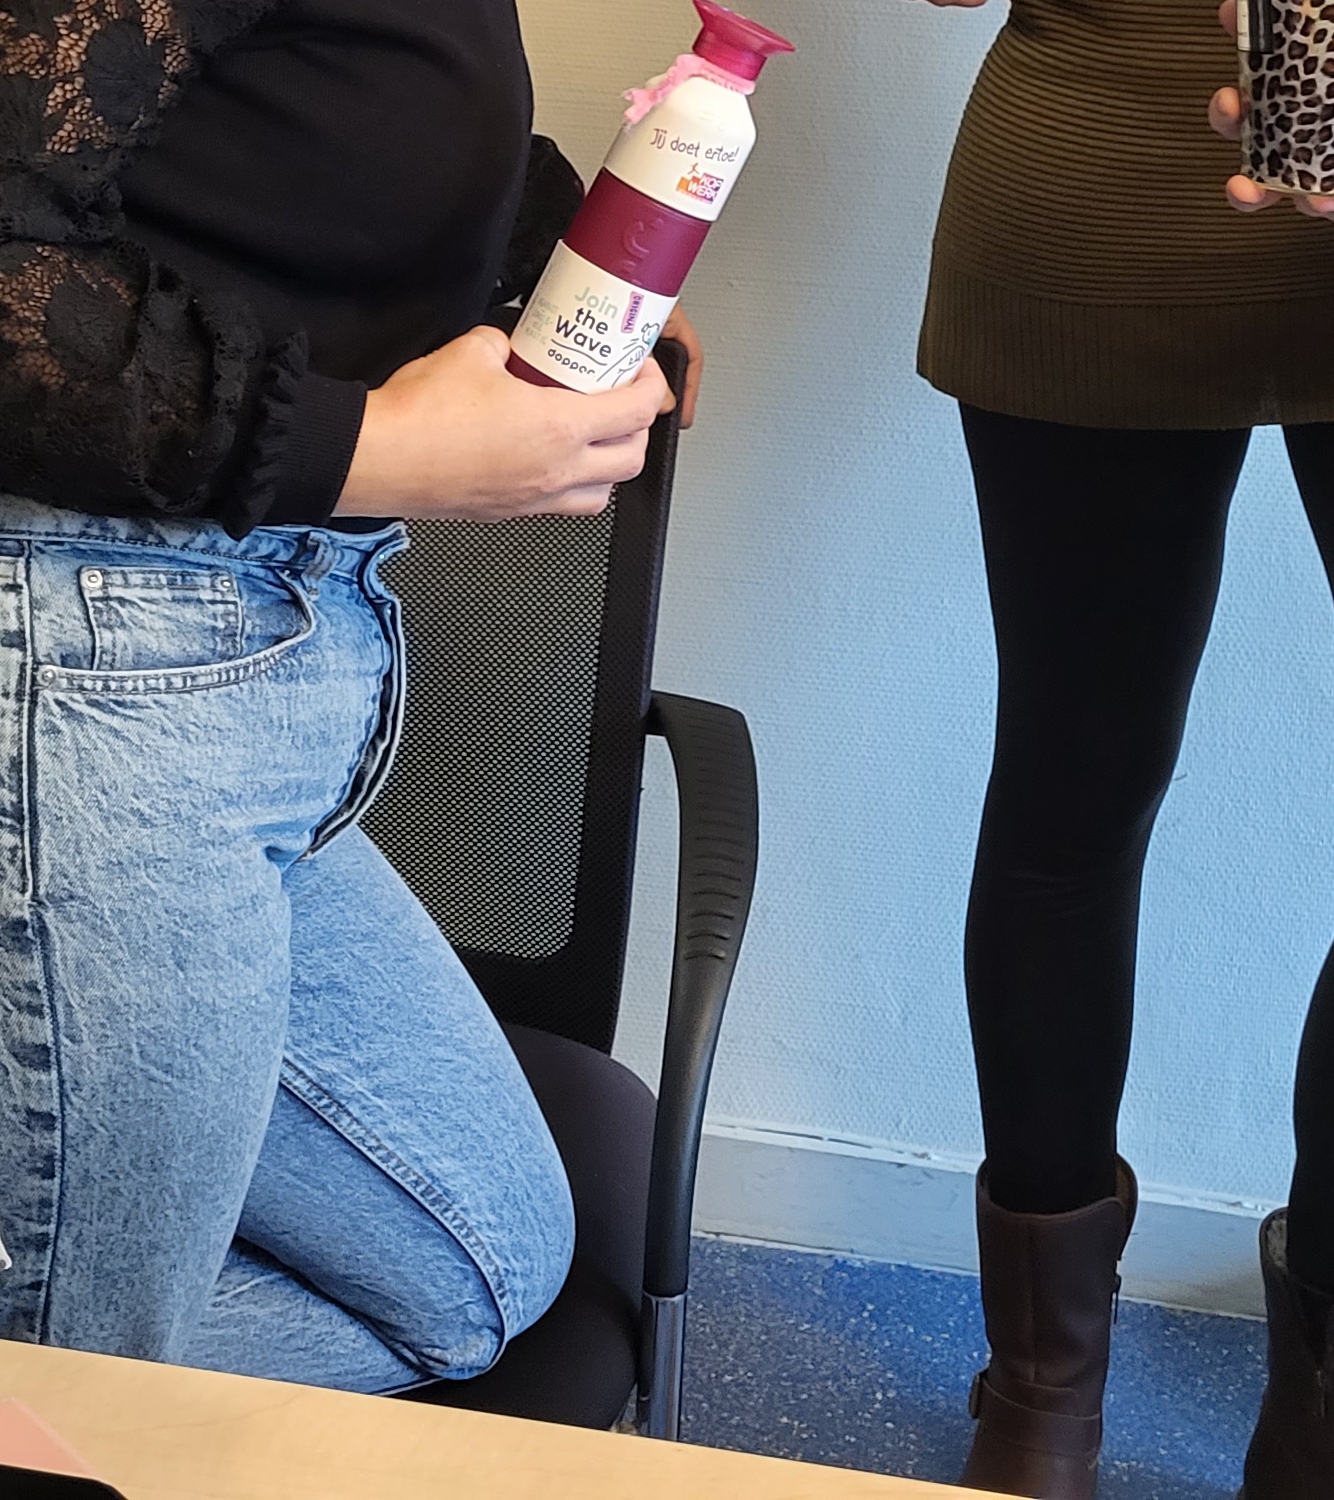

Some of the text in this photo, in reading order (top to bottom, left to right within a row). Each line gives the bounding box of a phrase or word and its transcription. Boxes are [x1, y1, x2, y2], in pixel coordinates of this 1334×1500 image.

[670, 136, 701, 158] doet
[574, 286, 619, 320] Join
[555, 314, 612, 358] Wave
[574, 306, 609, 336] the
